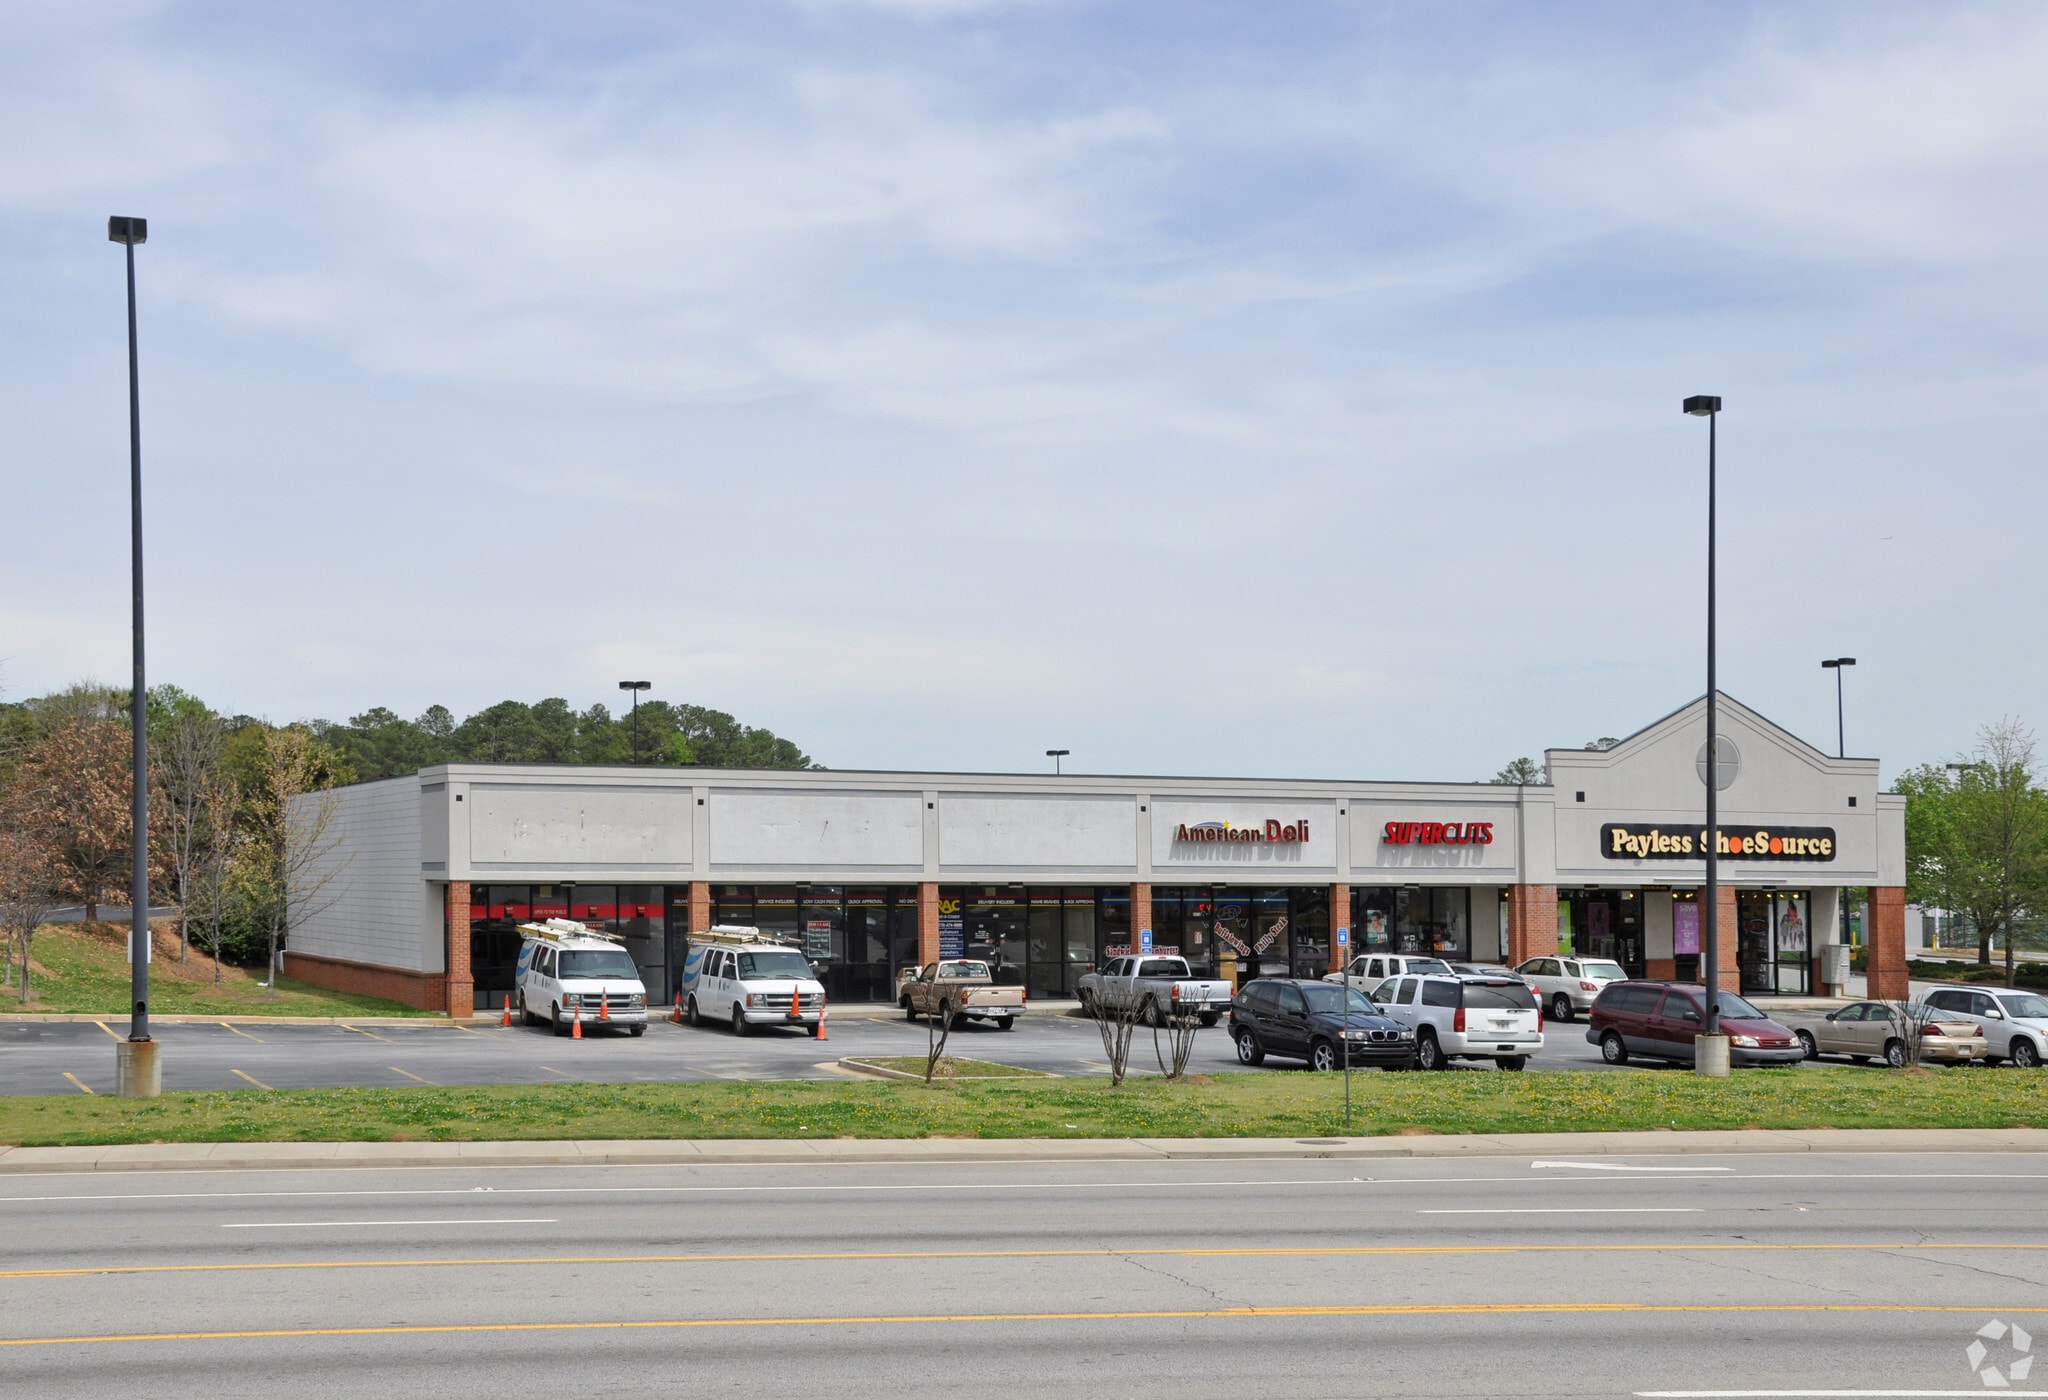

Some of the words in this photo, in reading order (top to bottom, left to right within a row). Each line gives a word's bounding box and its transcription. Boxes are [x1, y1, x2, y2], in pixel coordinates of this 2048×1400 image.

[1176, 822, 1261, 842] American
[1264, 818, 1310, 843] Deli
[1384, 821, 1494, 845] SUPERCUTS
[1611, 828, 1693, 858] Payless
[1214, 922, 1251, 956] Buffalowings
[1253, 932, 1274, 955] Philly
[1269, 916, 1288, 937] Steak
[1151, 944, 1179, 957] amburger
